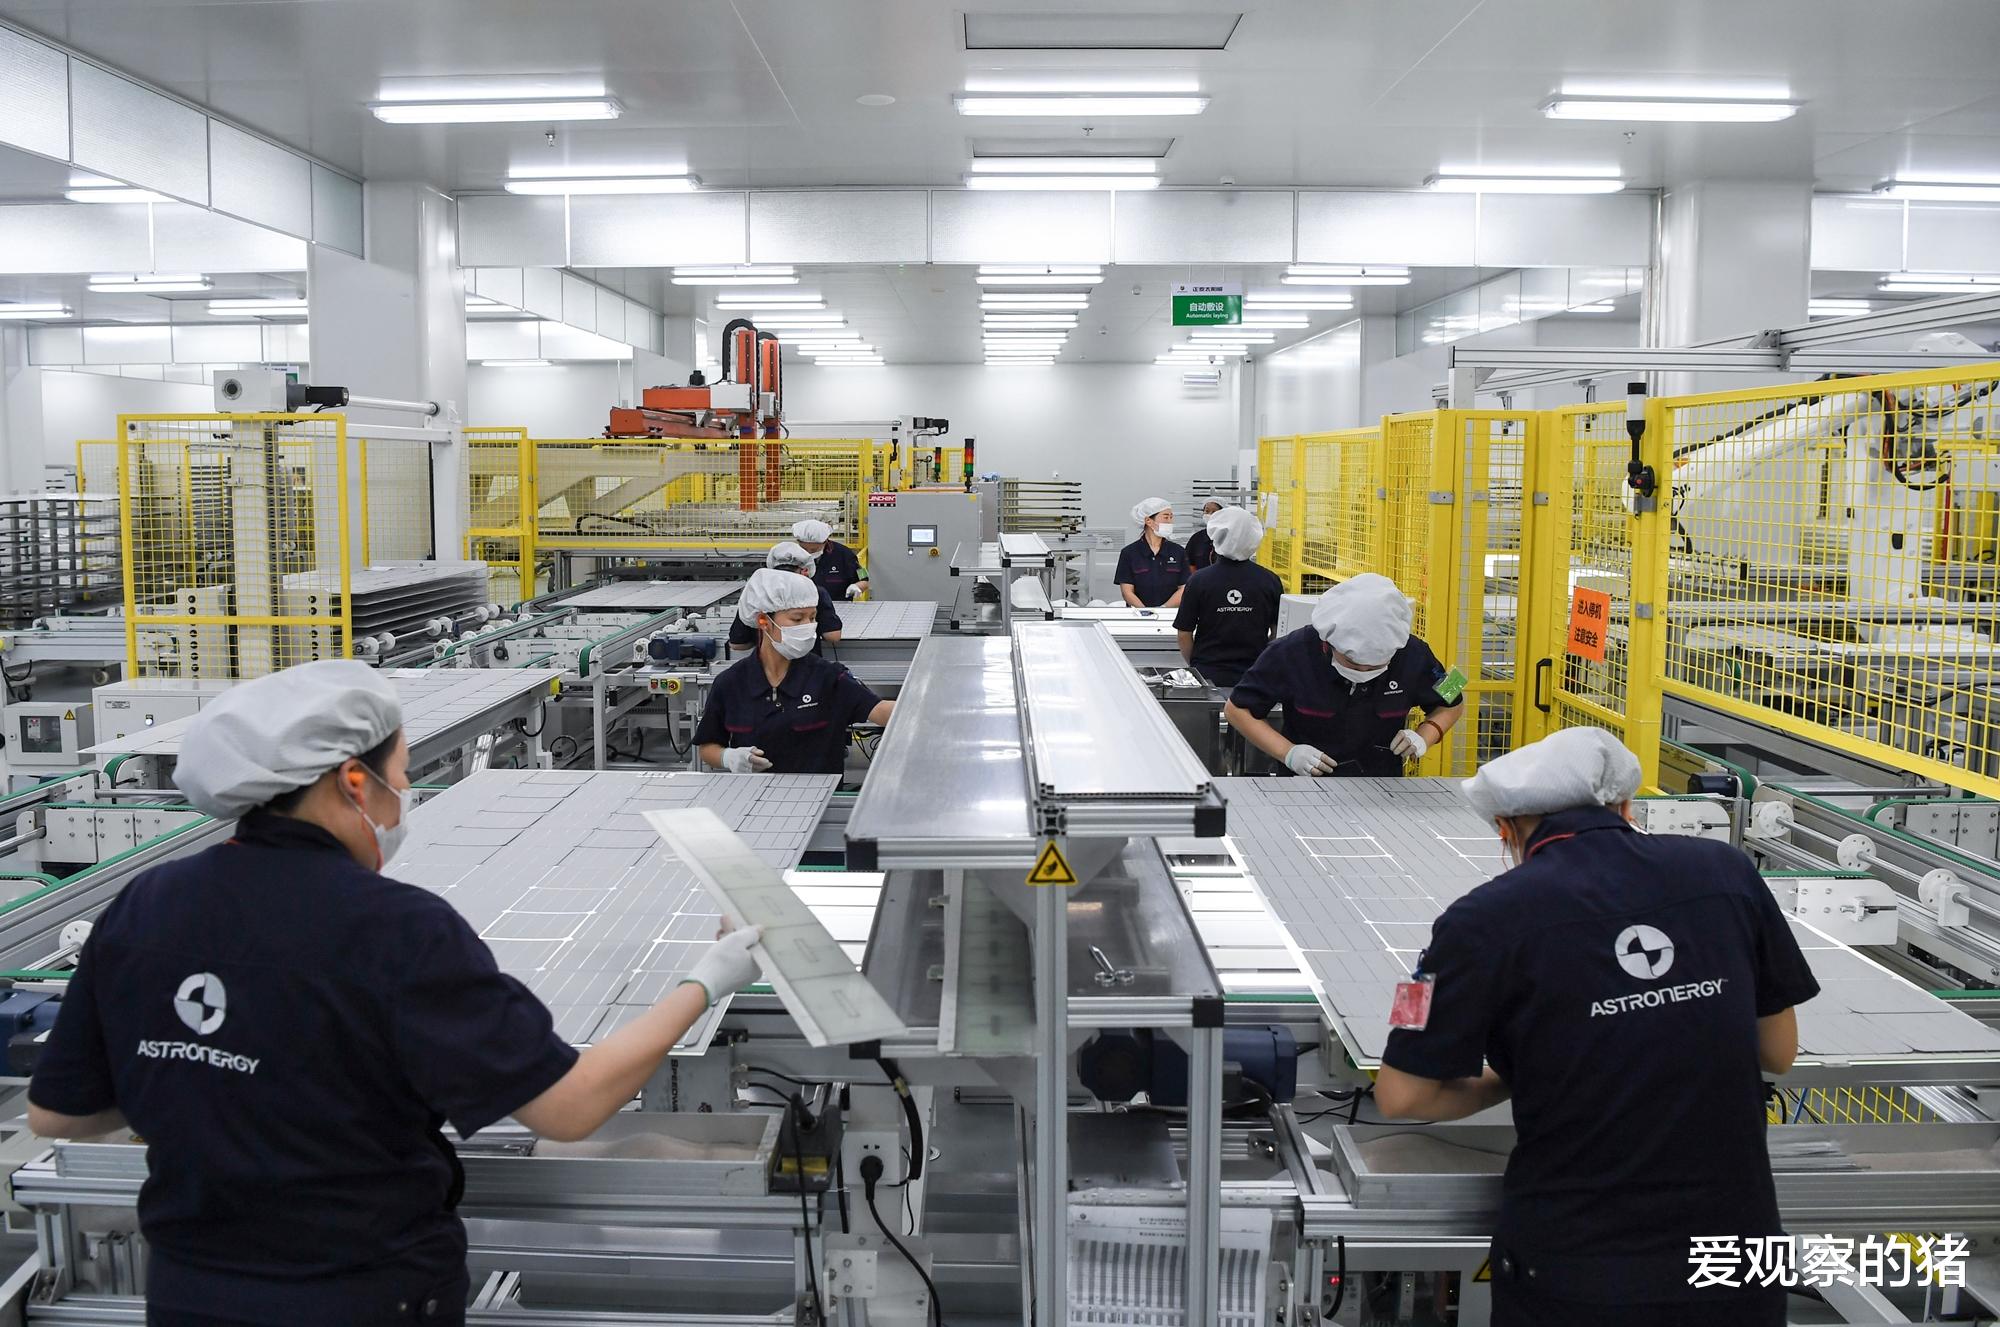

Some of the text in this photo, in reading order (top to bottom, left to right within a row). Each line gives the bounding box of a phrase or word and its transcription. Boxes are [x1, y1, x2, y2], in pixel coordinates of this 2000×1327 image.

[1189, 302, 1224, 312] 自动敷设
[1577, 599, 1602, 620] 进入停机
[1574, 626, 1598, 648] 注意安全
[1590, 978, 1723, 1017] ASTRONERGY
[137, 1039, 260, 1075] ASTRONERGY
